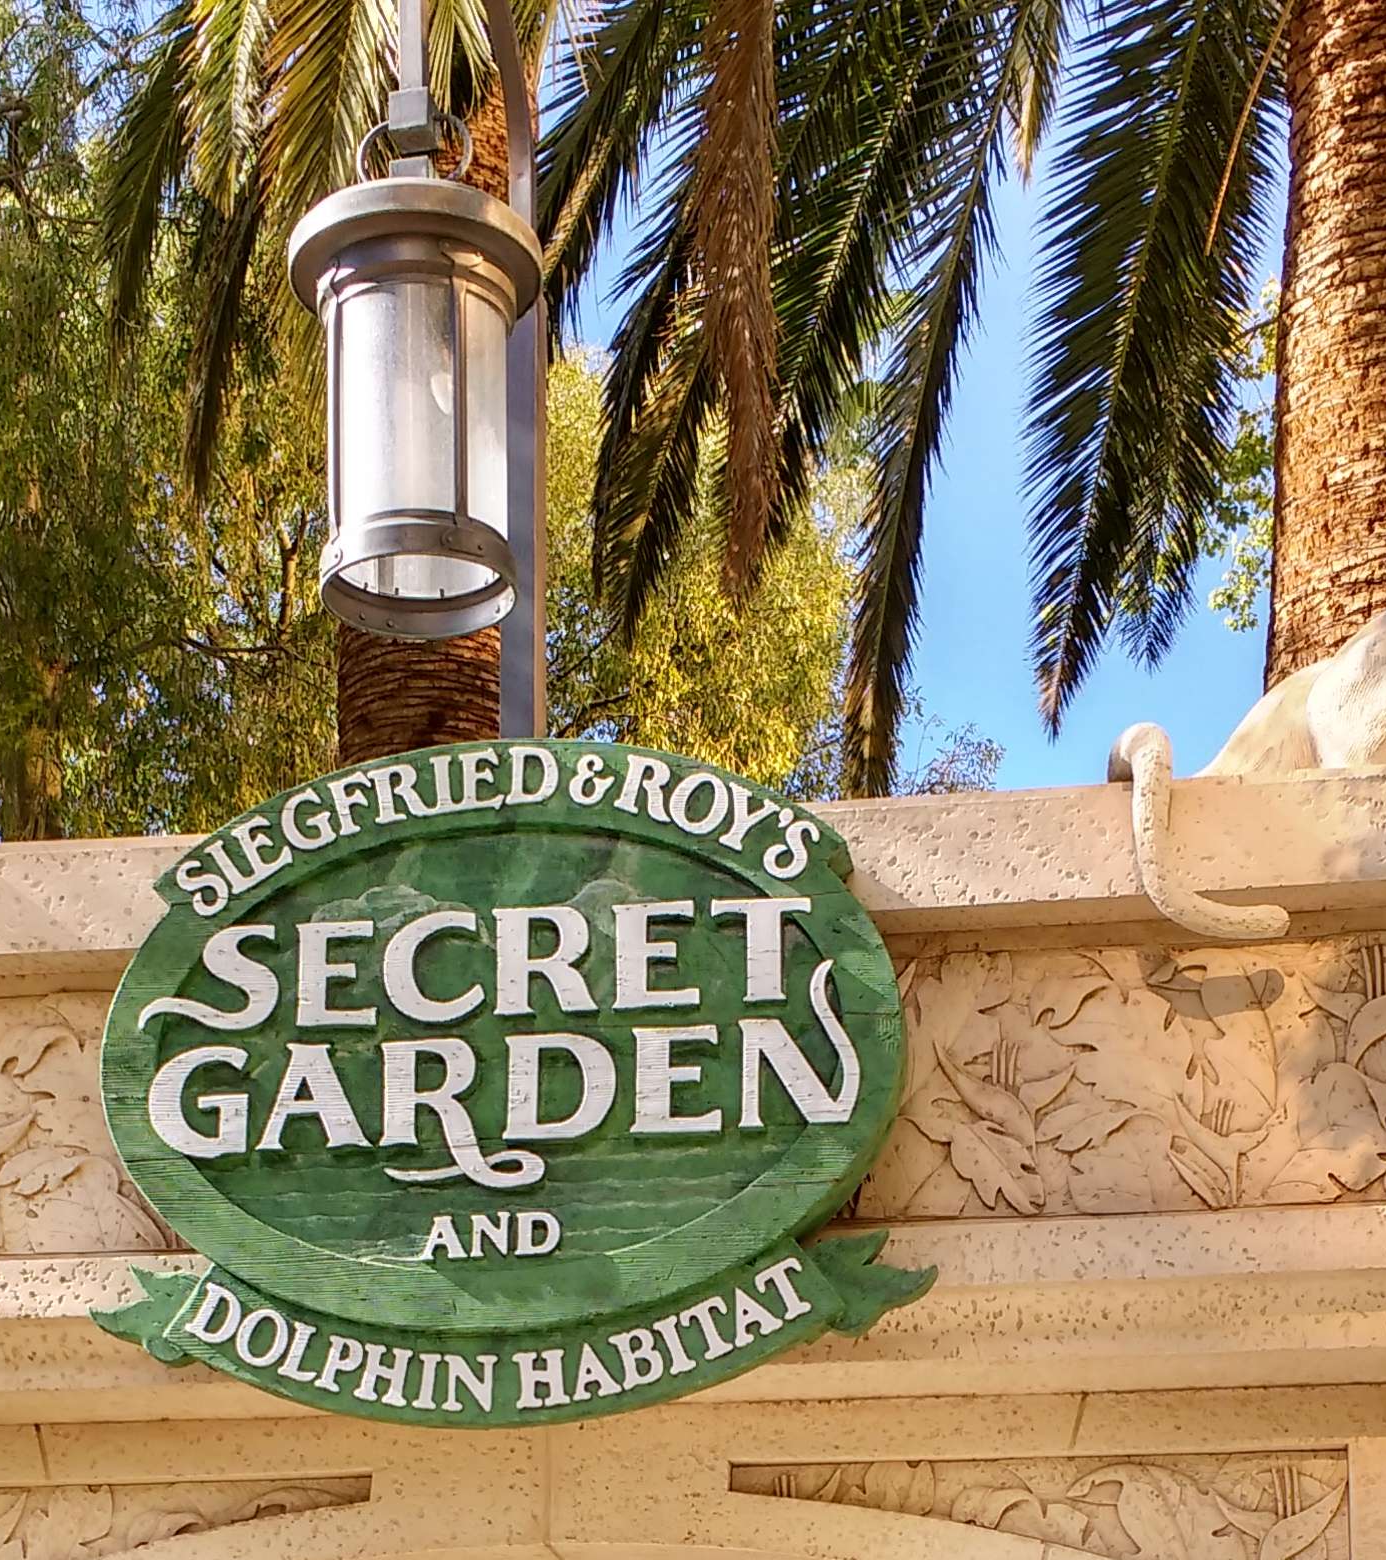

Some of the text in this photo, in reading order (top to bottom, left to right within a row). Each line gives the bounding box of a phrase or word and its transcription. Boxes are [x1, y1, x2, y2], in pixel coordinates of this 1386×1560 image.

[175, 745, 820, 917] SIEGFRIED & ROY'S
[138, 897, 813, 1032] SECRET
[147, 959, 862, 1190] GARDEN
[420, 1211, 561, 1261] AND
[184, 1256, 812, 1413] DOLPHIN HABITAT
